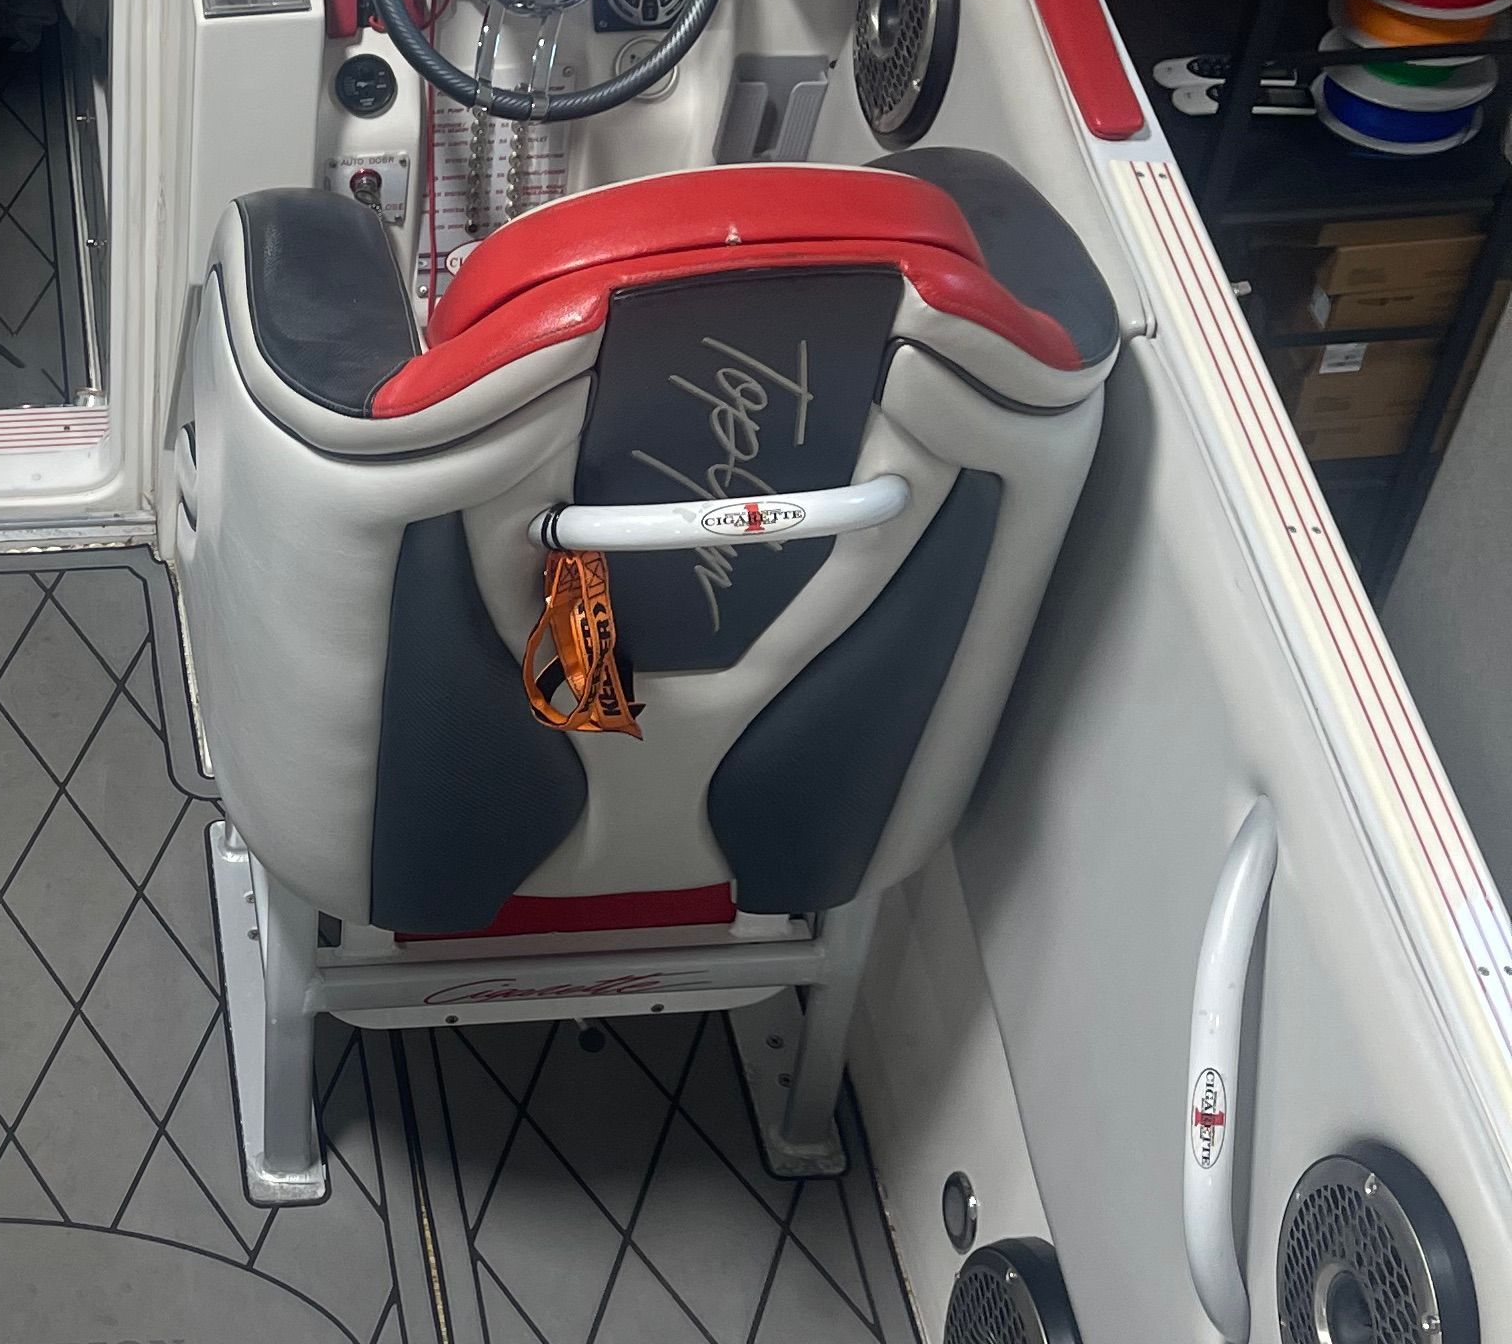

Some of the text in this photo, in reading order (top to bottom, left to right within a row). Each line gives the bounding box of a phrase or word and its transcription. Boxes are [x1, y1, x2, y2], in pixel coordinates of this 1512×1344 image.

[341, 158, 364, 167] AUTO
[704, 508, 803, 526] CIGARETTE
[1201, 1069, 1216, 1167] CIGARETTE
